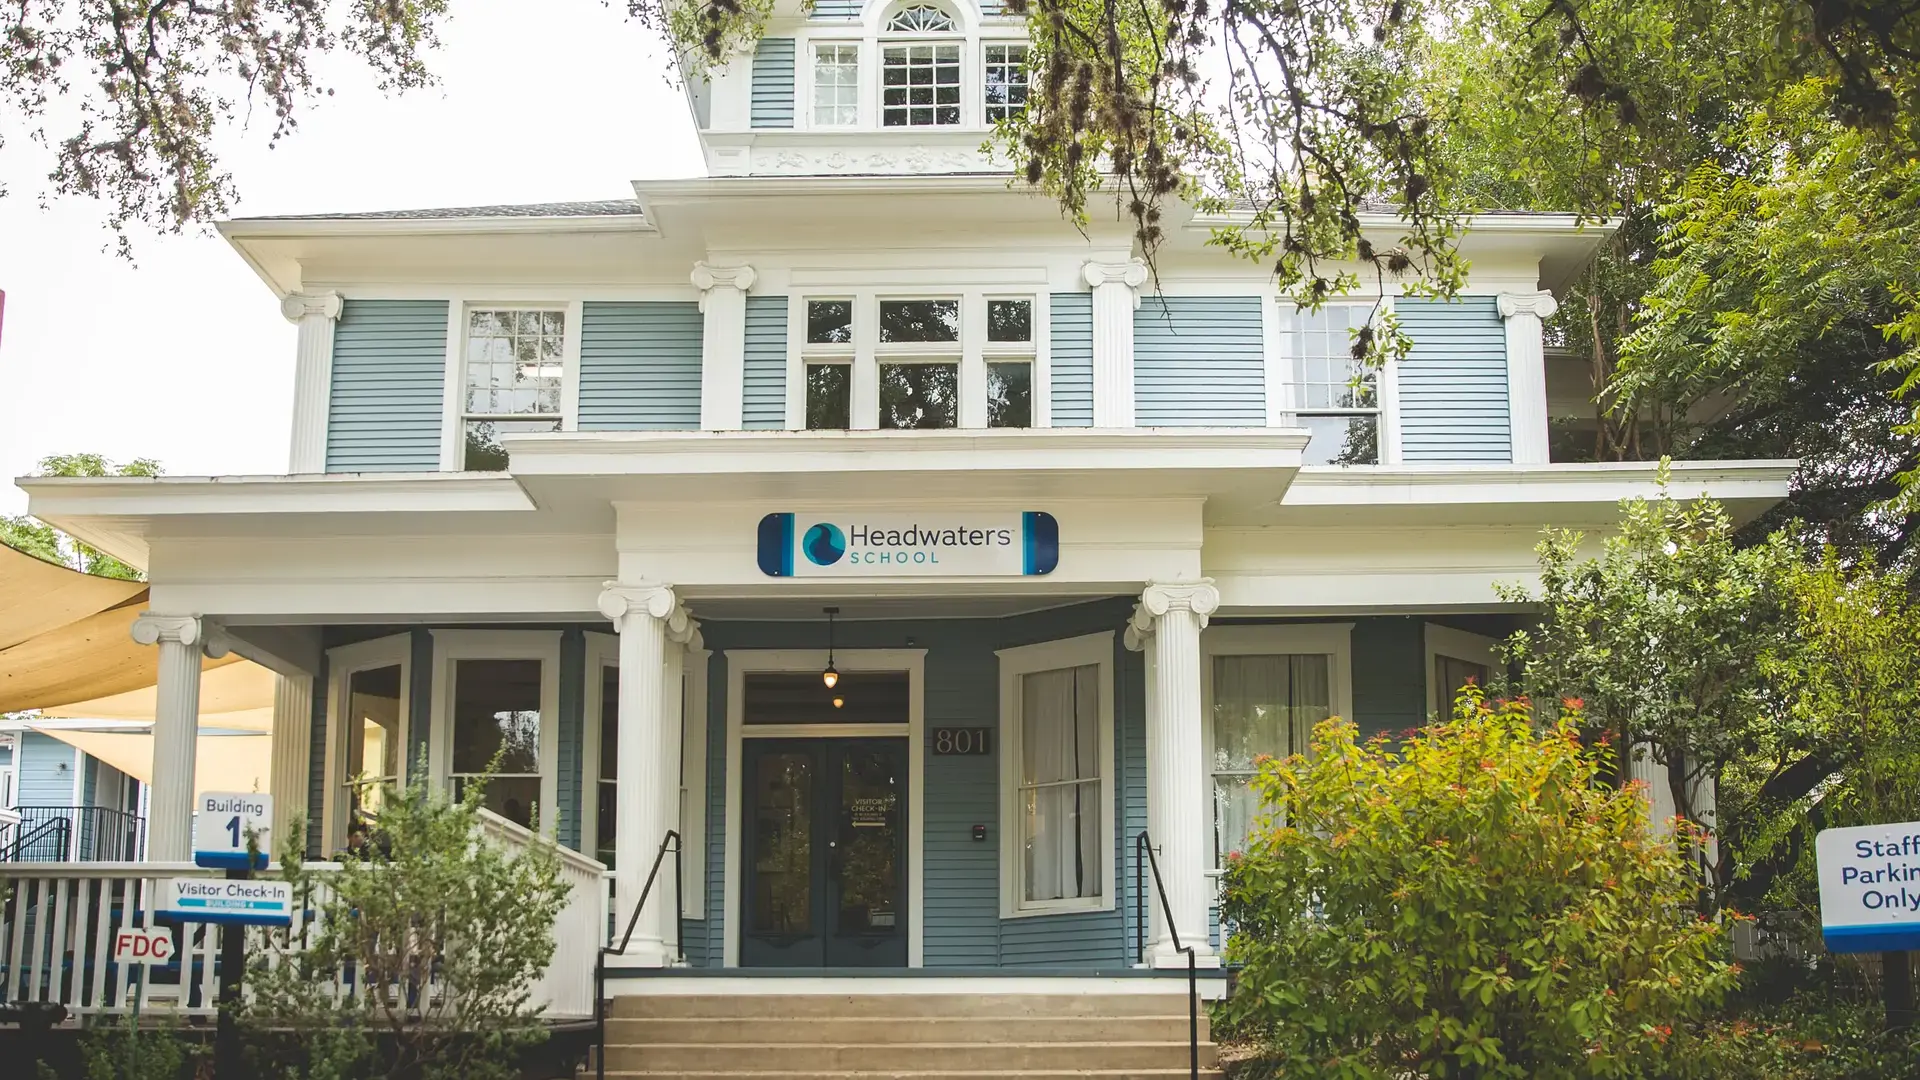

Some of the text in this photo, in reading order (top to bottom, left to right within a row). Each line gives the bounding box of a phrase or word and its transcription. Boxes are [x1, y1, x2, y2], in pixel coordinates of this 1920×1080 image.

[850, 524, 1011, 546] Headwaters
[850, 552, 939, 564] SCHOOL
[936, 729, 984, 753] 801
[206, 799, 263, 816] Building
[226, 816, 240, 848] 1
[1855, 835, 1920, 858] Staff
[1842, 862, 1920, 885] Parkin
[177, 882, 285, 899] Visitor Check-In
[1862, 887, 1920, 911] Only
[117, 935, 169, 958] FDC
